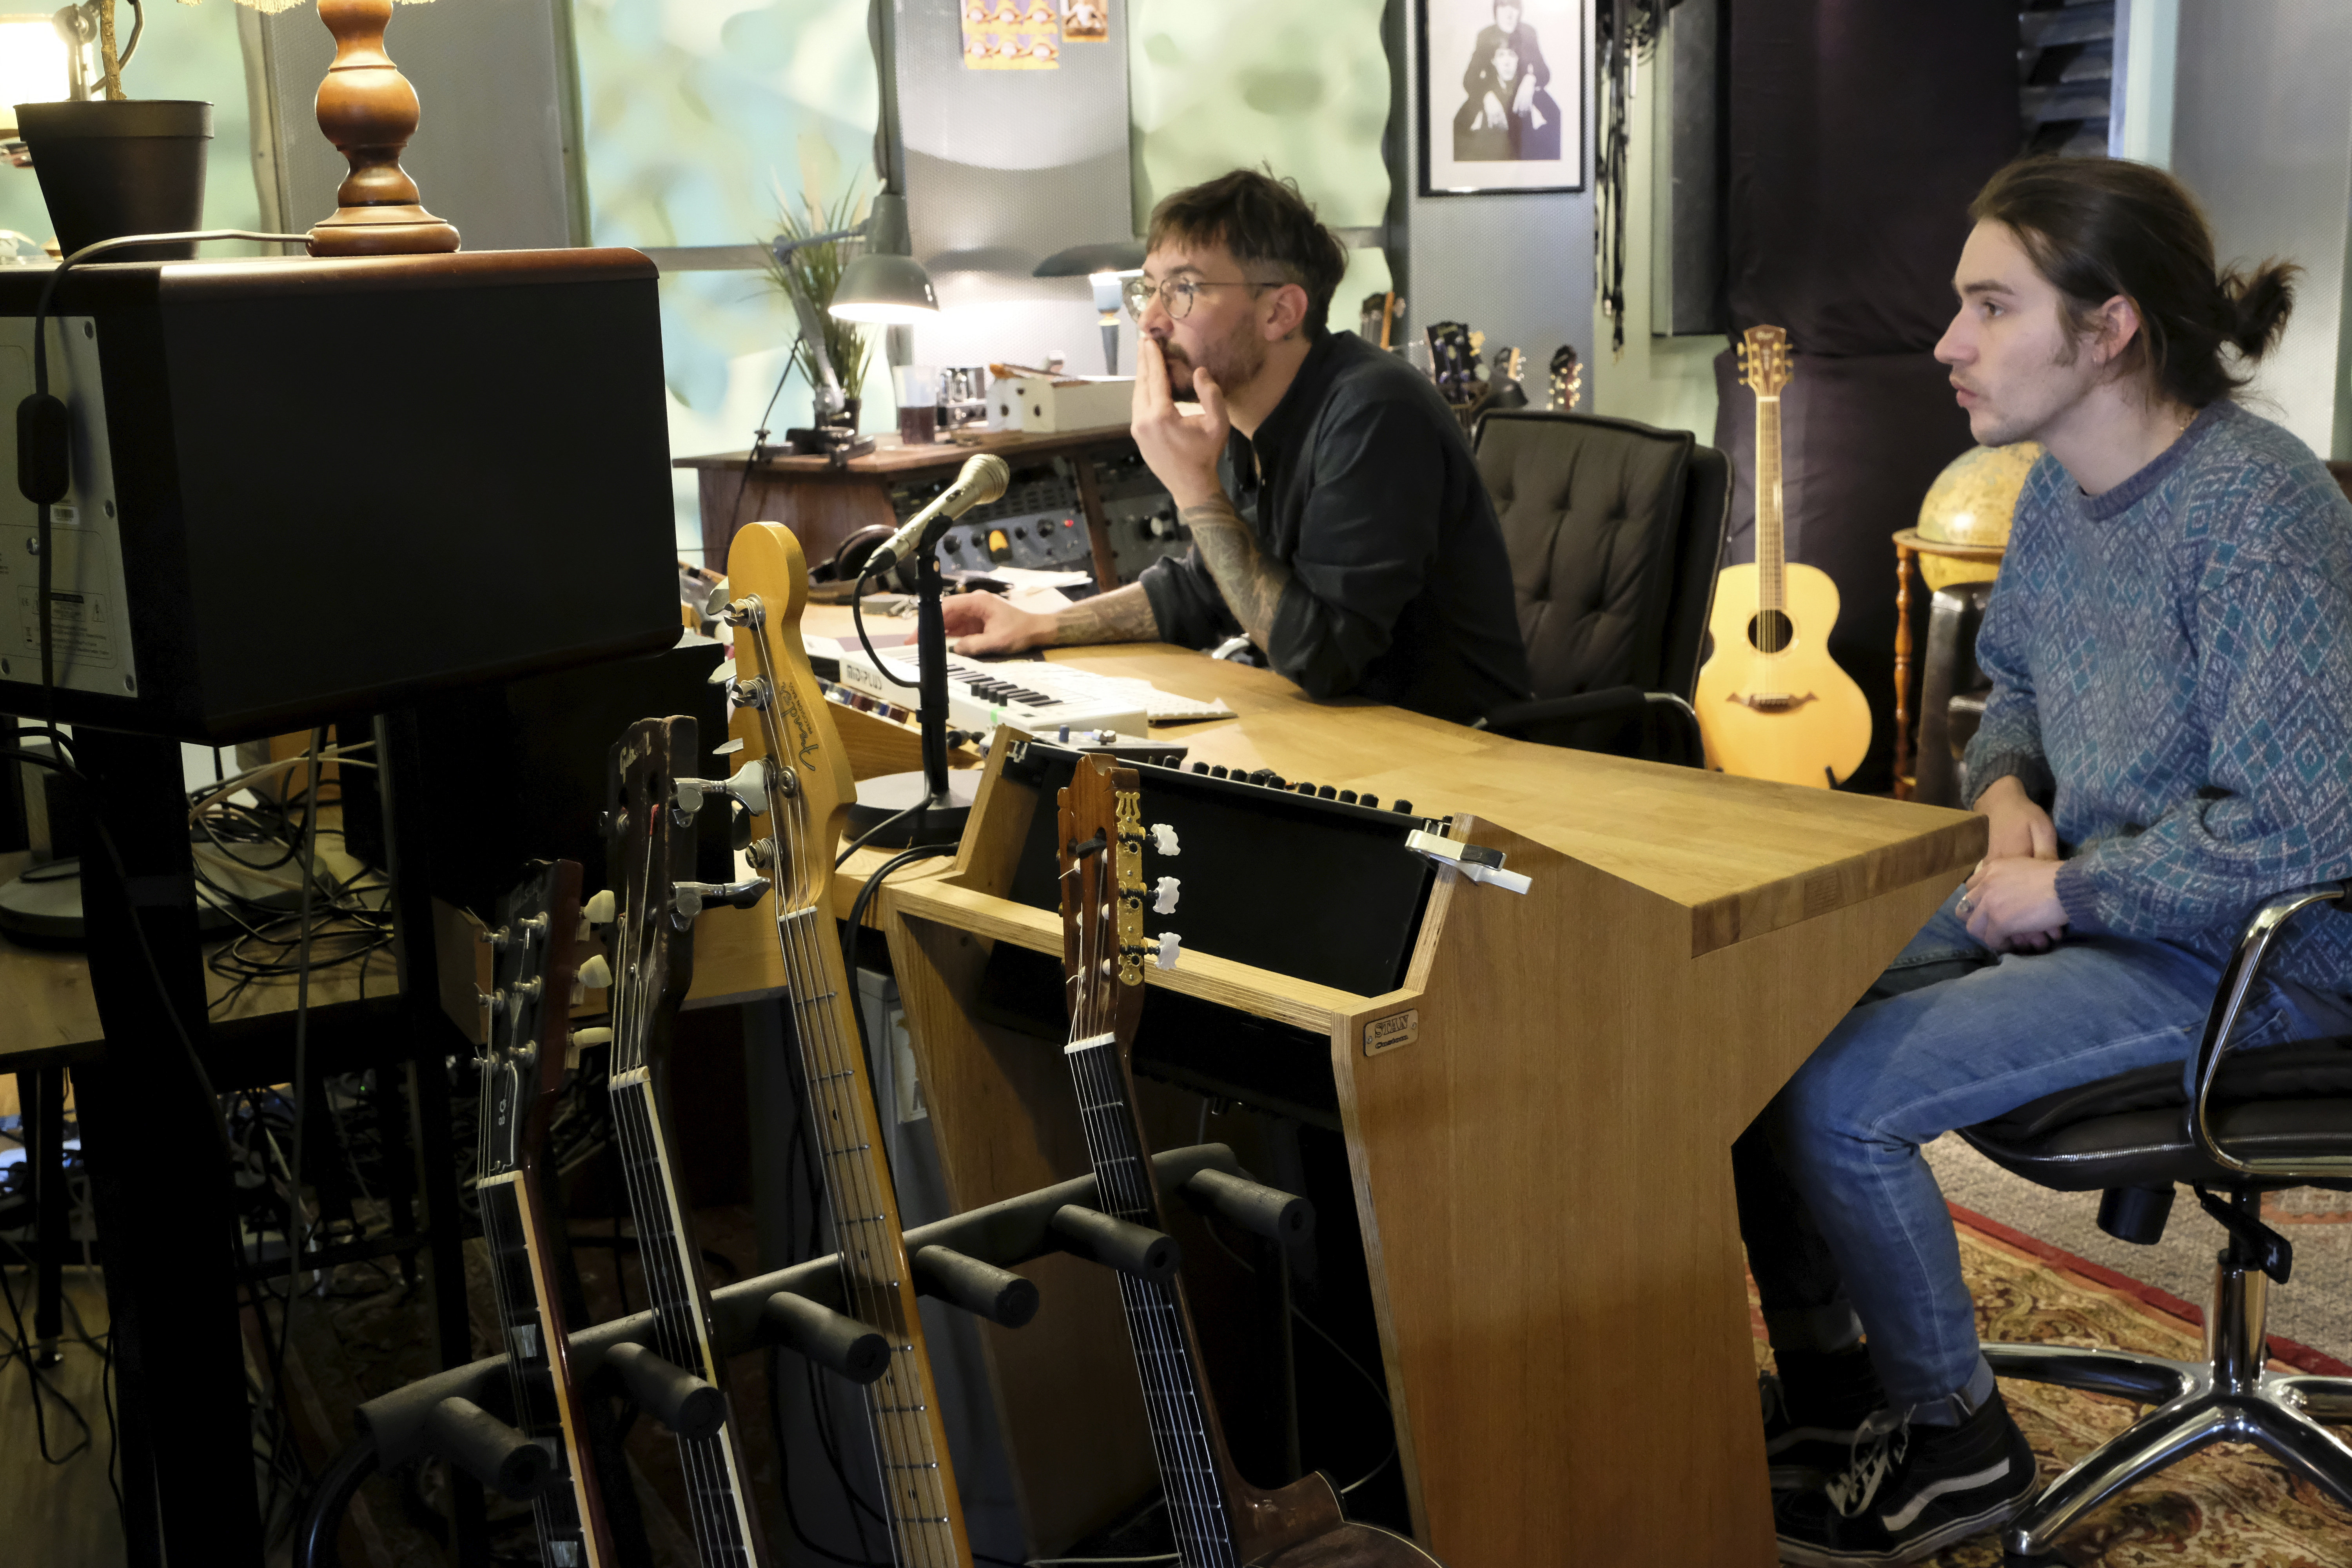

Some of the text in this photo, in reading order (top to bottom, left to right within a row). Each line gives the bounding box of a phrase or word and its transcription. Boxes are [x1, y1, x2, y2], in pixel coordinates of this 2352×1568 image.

[780, 681, 819, 771] Fender
[788, 682, 813, 734] PRECISION BASS
[1375, 1014, 1409, 1038] STAN
